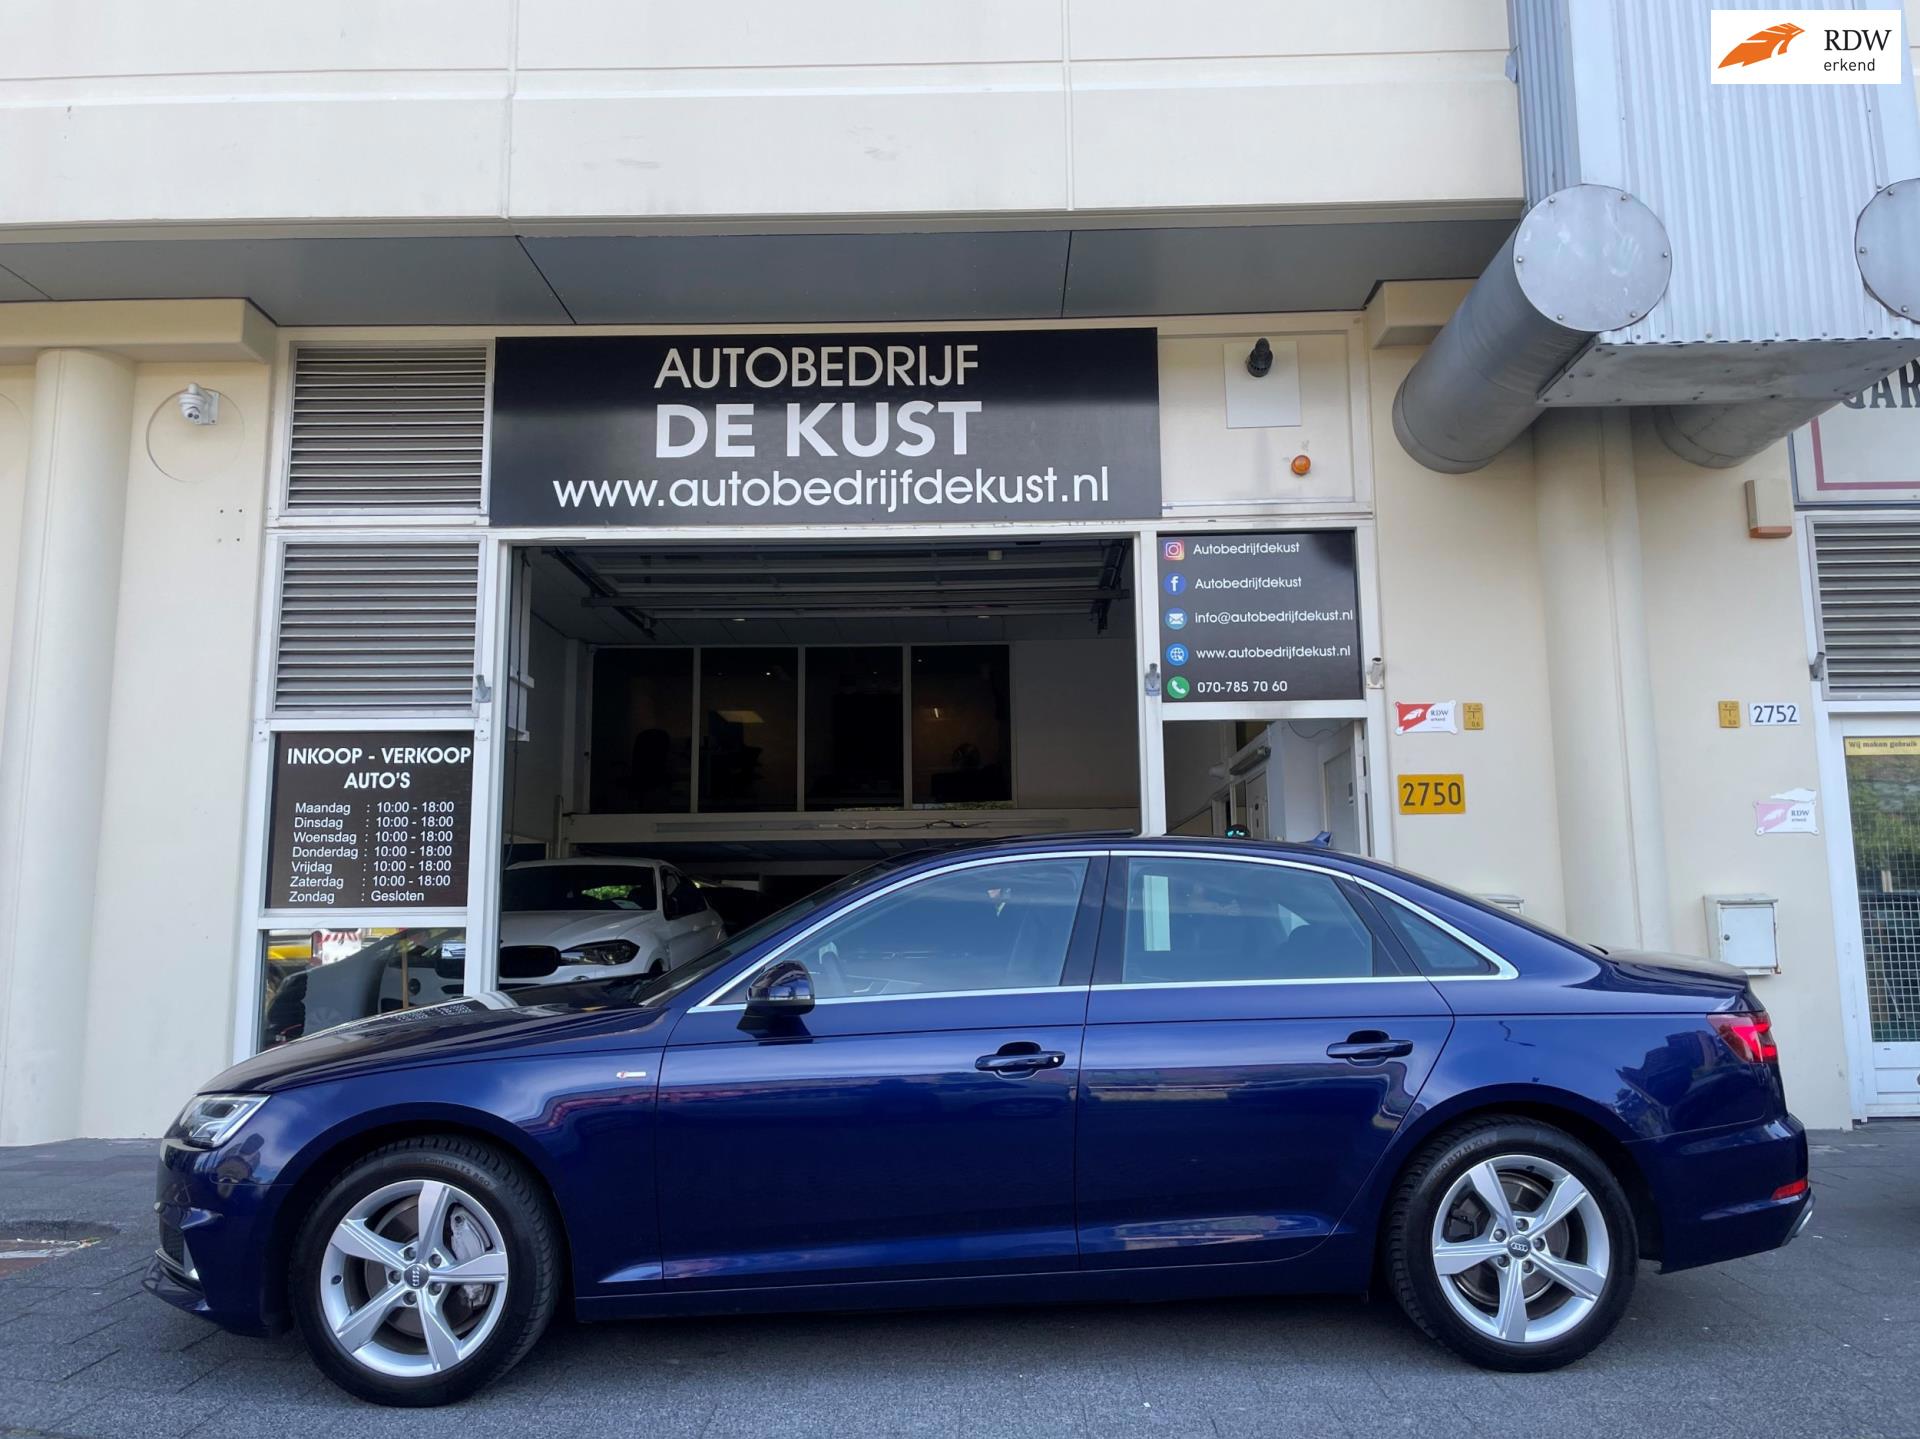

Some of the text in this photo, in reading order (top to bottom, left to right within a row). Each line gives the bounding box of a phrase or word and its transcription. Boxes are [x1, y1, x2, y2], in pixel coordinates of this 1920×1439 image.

[654, 345, 978, 388] AUTOBEDRIJF
[656, 401, 981, 458] DE KUST
[553, 466, 1108, 512] www.autobedrijfdekust.nl
[1193, 542, 1299, 555] Autobedrijfdekust
[1195, 577, 1301, 589] Autobedrijfdekust
[1195, 610, 1353, 624] info@autobedrijfdekust.nl
[1196, 645, 1350, 659] www.autobedrijfdekust.nl
[1198, 681, 1287, 692] 070-785 70 60
[1754, 705, 1797, 723] 2752
[288, 748, 362, 764] INKOOP
[381, 747, 471, 763] VERKOOP
[1403, 783, 1461, 806] 2750
[296, 803, 350, 815] Maandag
[377, 802, 409, 812] 10:00
[421, 802, 454, 812] 18:00
[295, 817, 343, 830] Dinsdag
[376, 817, 408, 827] 10:00
[421, 816, 453, 827] 18:00
[294, 832, 356, 844] Woensdag
[375, 831, 407, 842] 10:00
[420, 831, 452, 841] 18:00
[293, 847, 358, 859] Donderdag
[374, 846, 407, 856] 10:00
[419, 845, 452, 856] 18:00
[292, 861, 332, 874] Vrijdag
[373, 861, 406, 871] 10:00
[418, 860, 451, 871] 18:00
[290, 876, 343, 889] Zaterdag
[372, 876, 405, 886] 10:00
[417, 875, 450, 886] 18:00
[289, 891, 334, 904] Zondag
[371, 891, 424, 901] Gesloten
